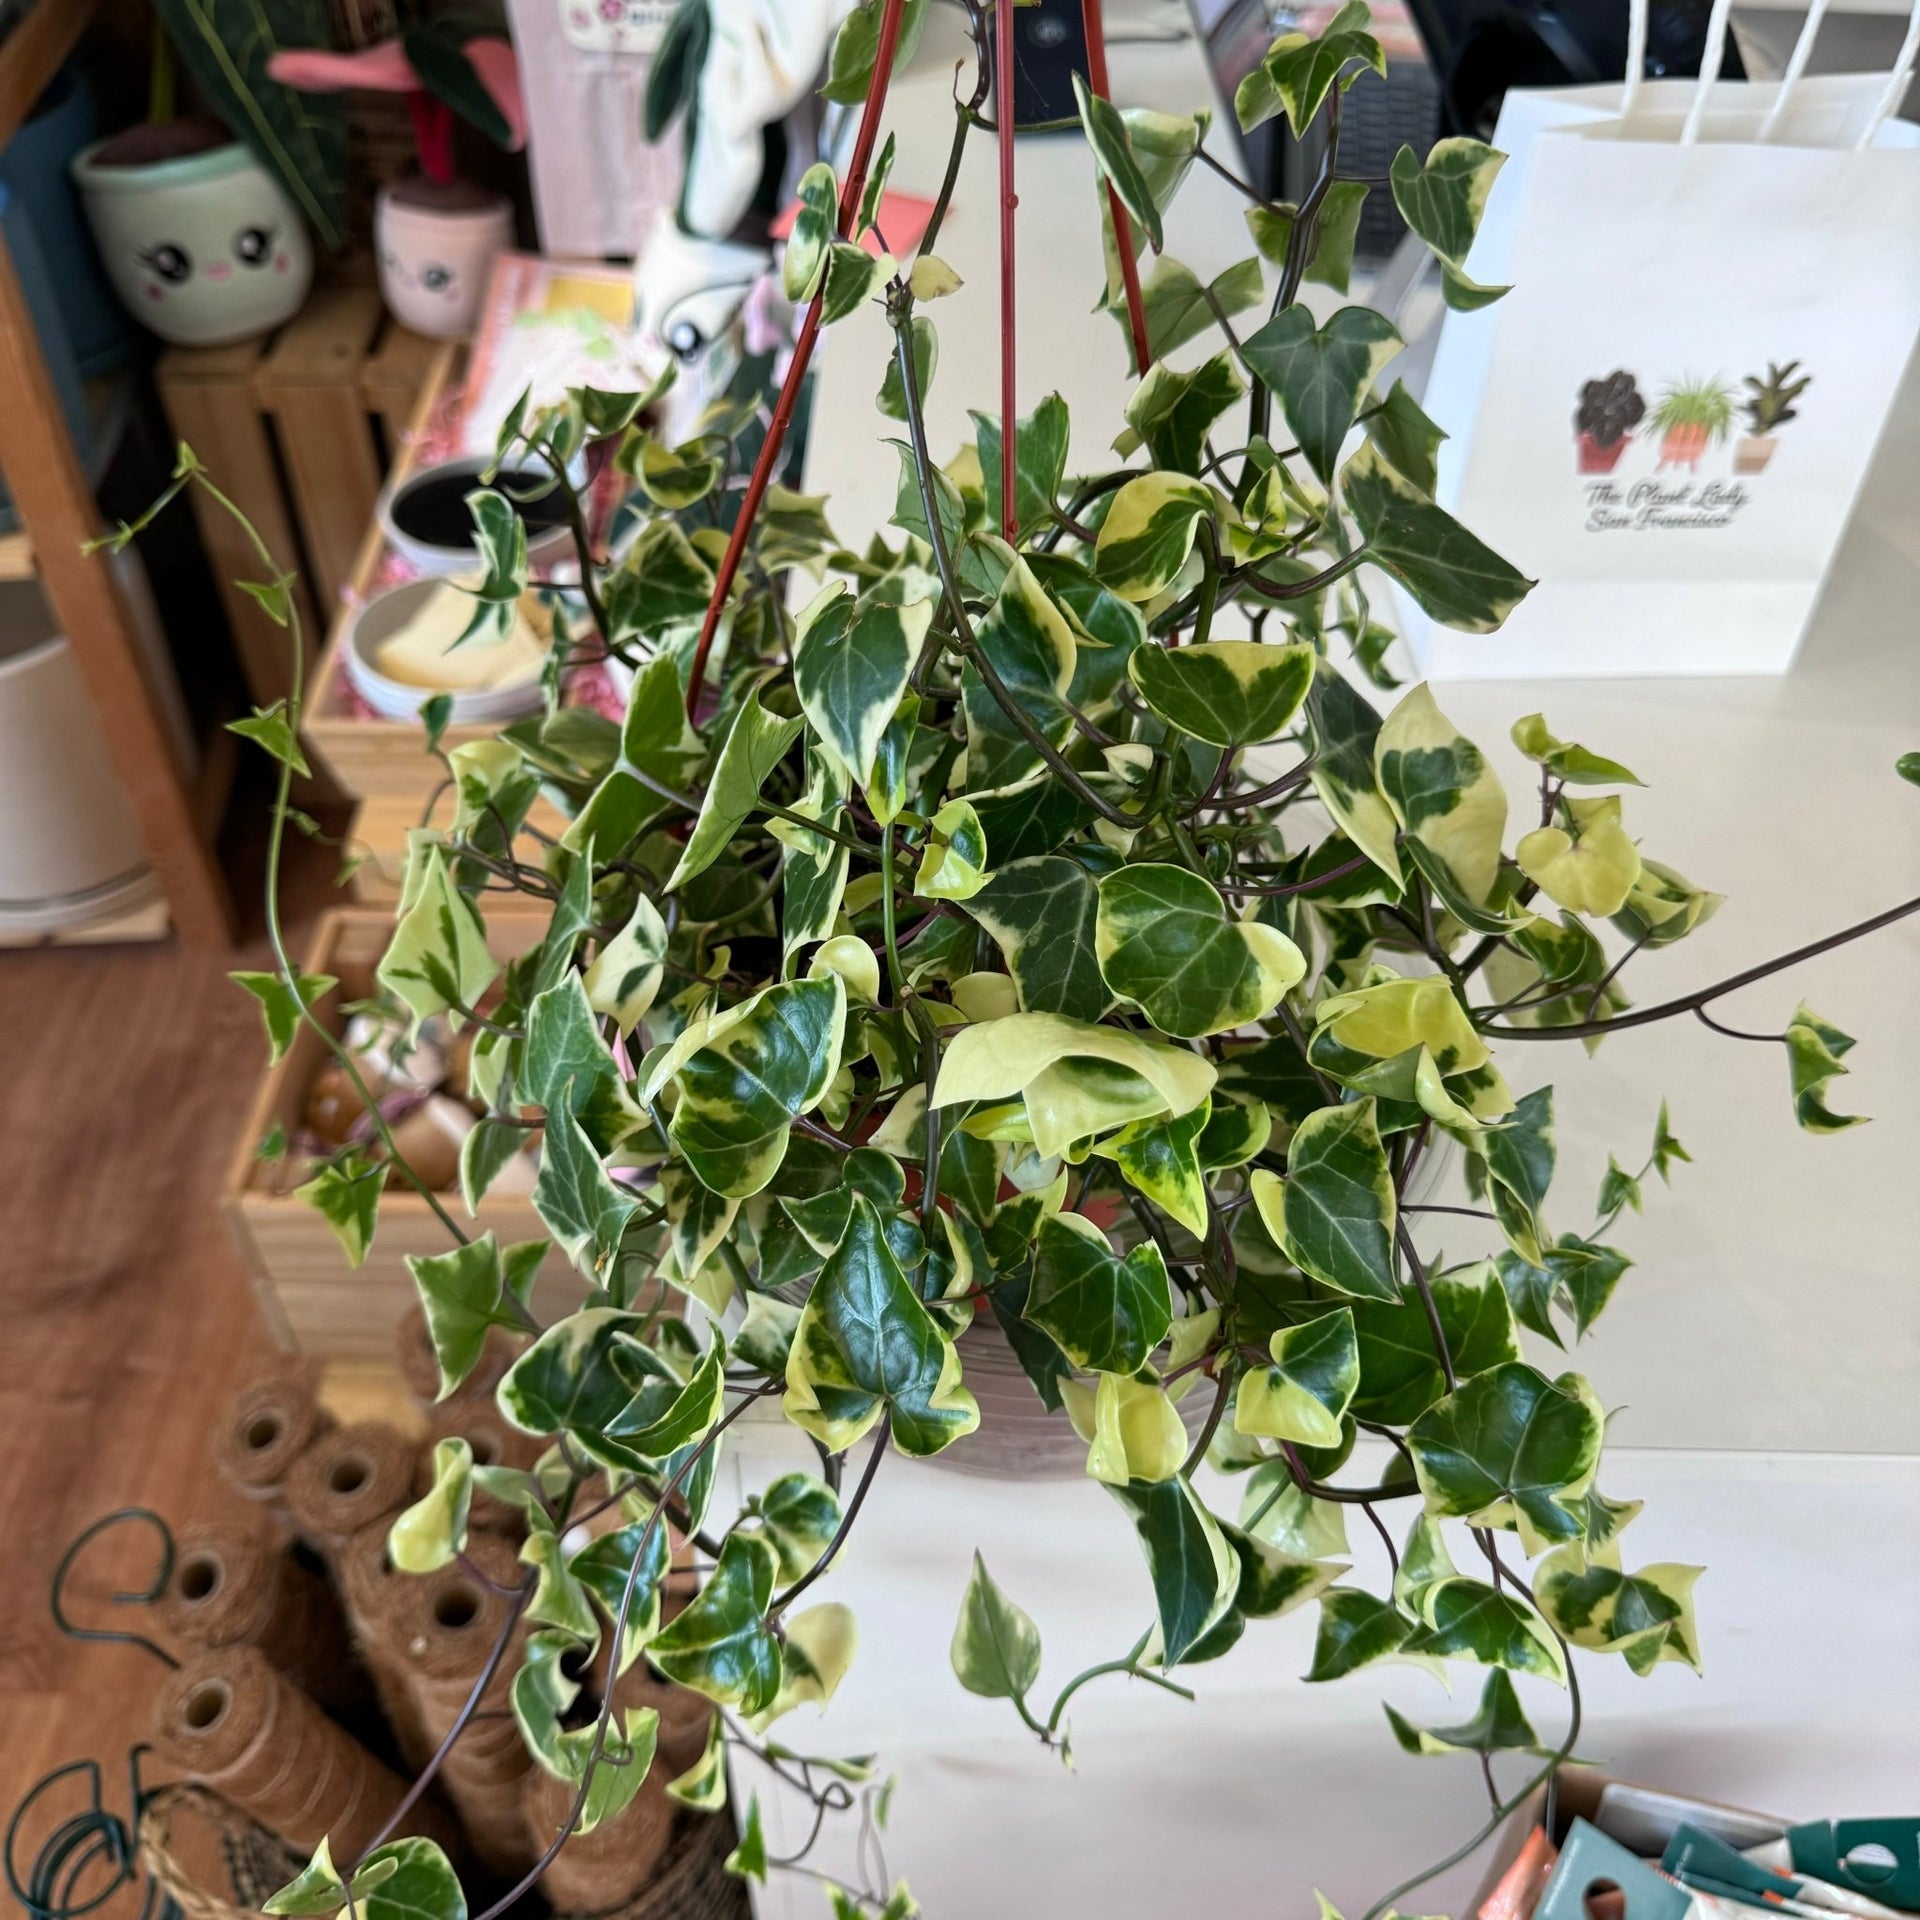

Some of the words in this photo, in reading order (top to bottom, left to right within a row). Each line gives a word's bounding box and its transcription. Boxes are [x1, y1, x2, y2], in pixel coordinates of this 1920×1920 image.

[1584, 479, 1623, 506] The
[1627, 478, 1692, 508] Plant
[1691, 478, 1751, 511] Lady
[1585, 508, 1631, 532] San
[1633, 508, 1734, 531] Francisco
